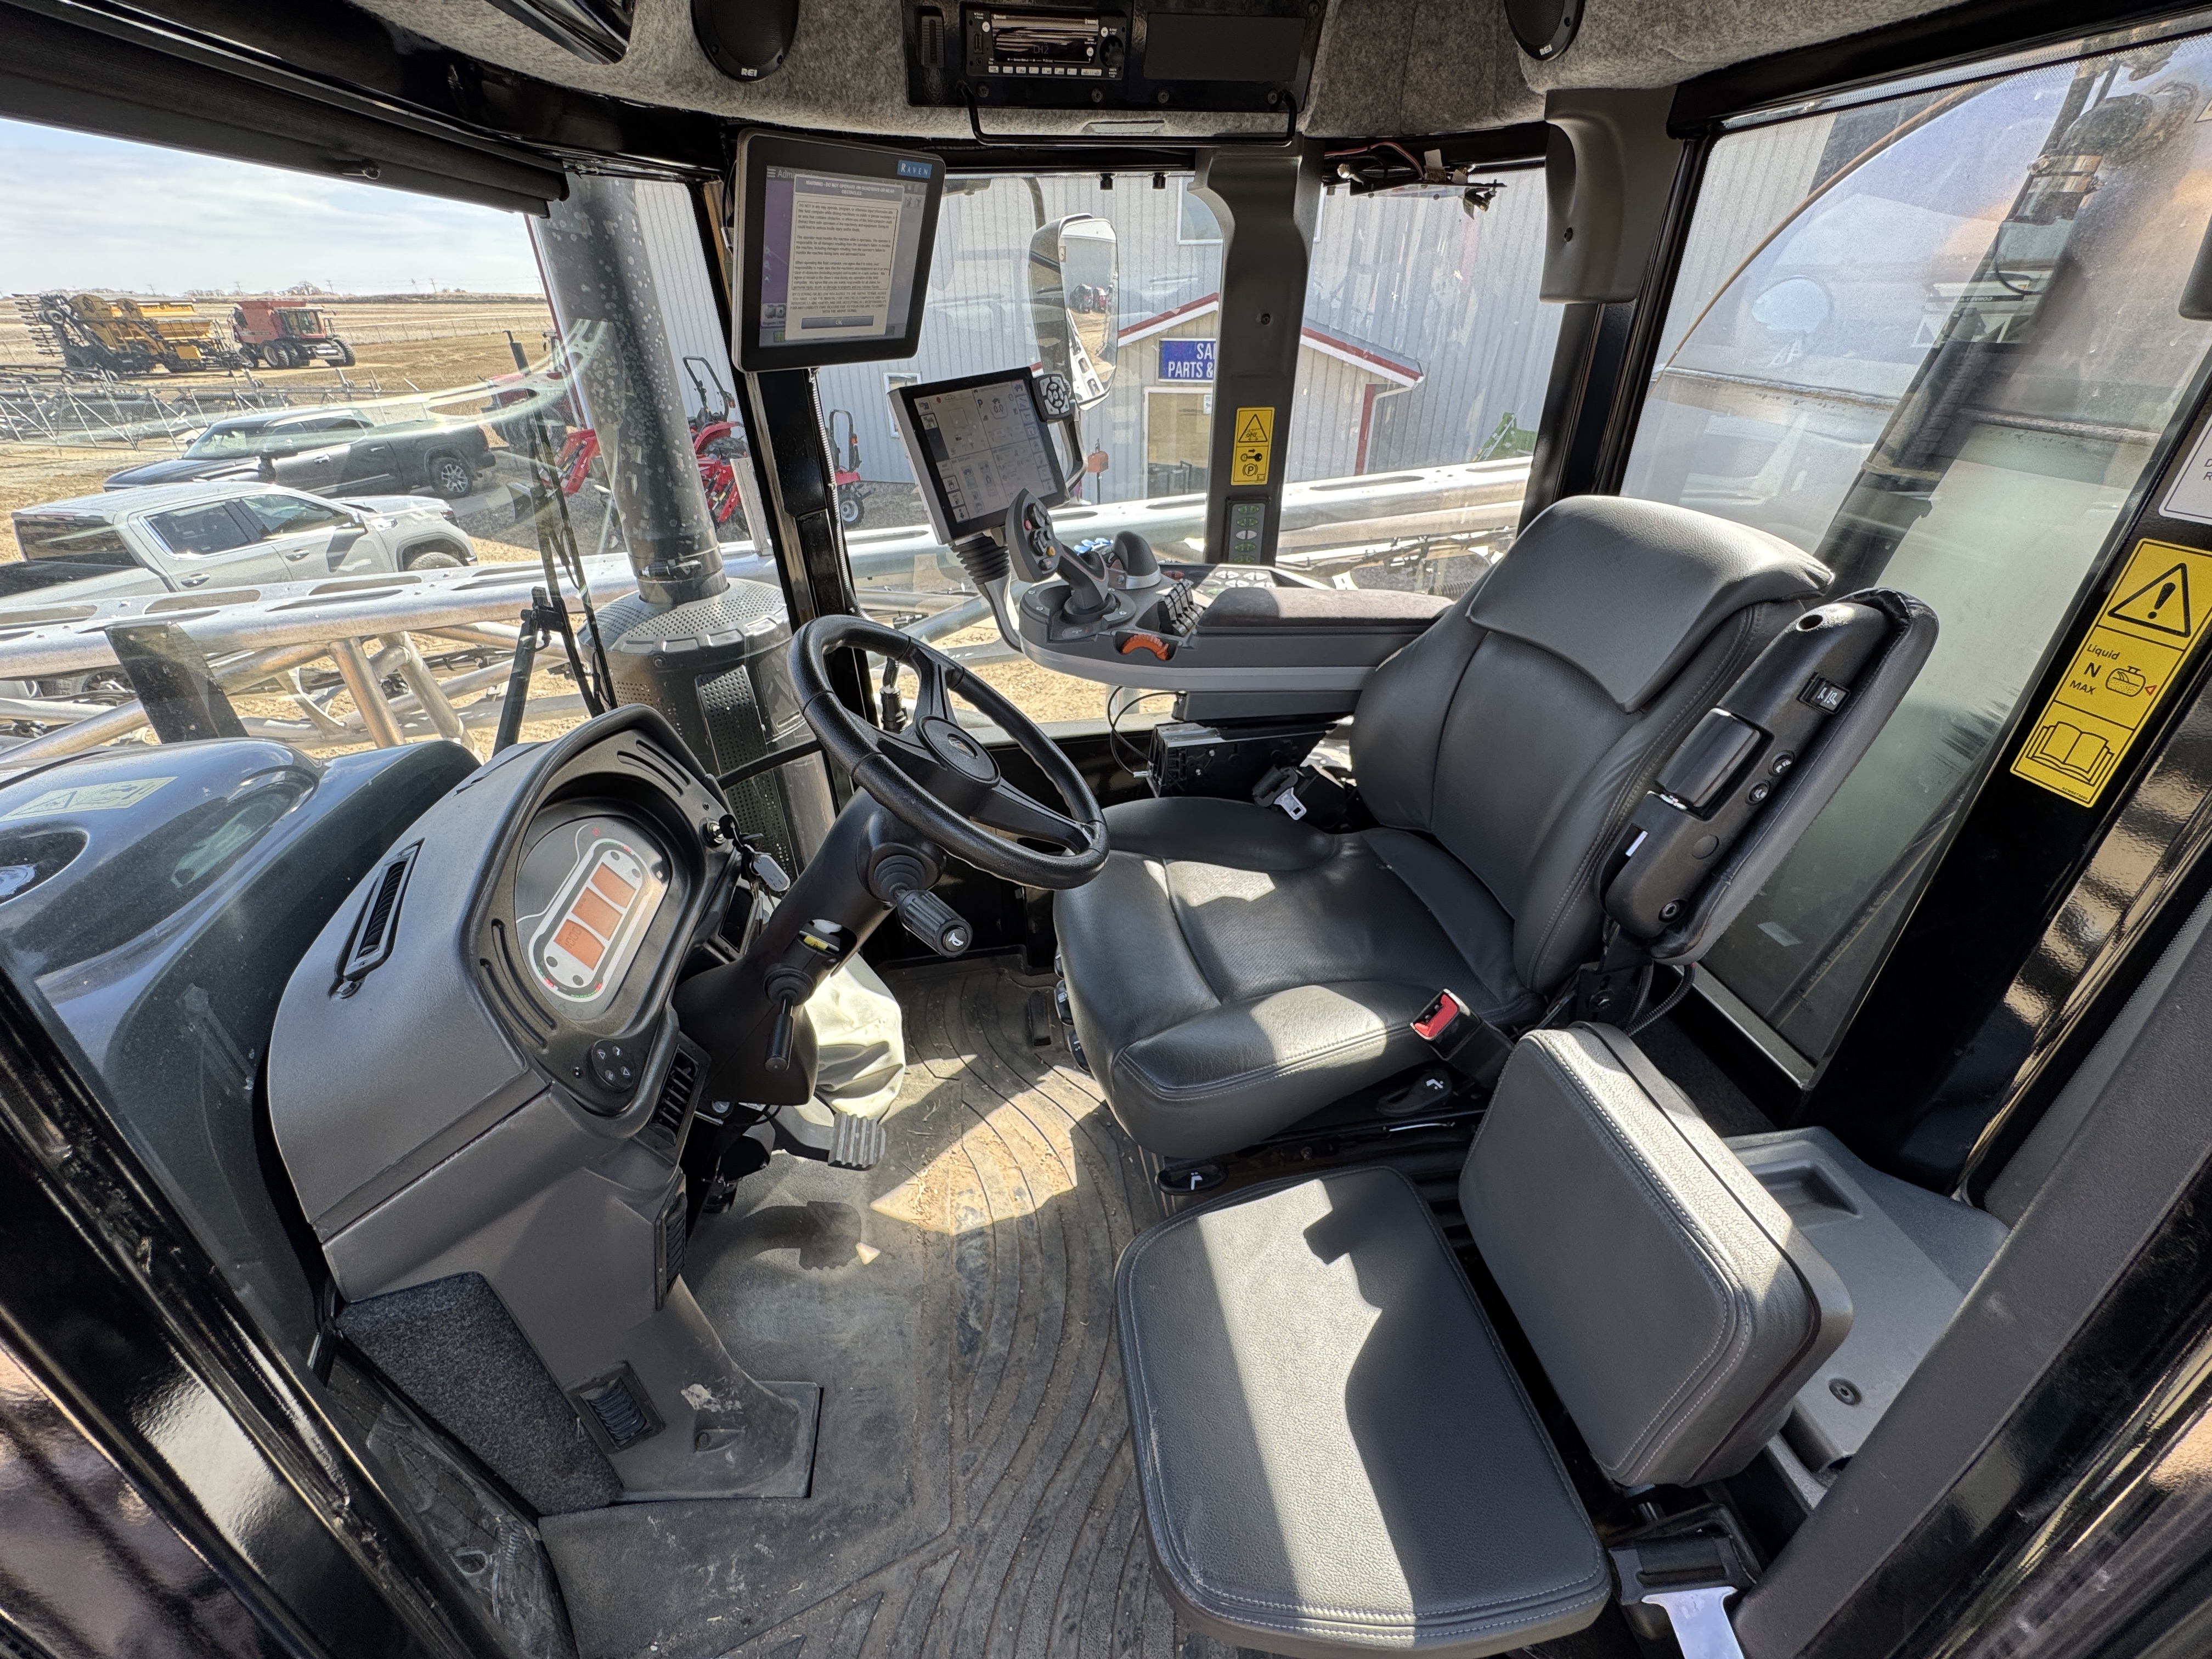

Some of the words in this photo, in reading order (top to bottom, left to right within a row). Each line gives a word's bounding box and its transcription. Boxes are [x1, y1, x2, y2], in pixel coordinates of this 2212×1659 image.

[1539, 44, 1553, 56] REI
[741, 67, 758, 77] REI
[901, 163, 928, 176] RAVEN
[1168, 361, 1204, 378] PARTS
[1206, 362, 1214, 378] &
[2086, 644, 2121, 661] Liquid
[2084, 662, 2102, 678] N
[2069, 680, 2096, 695] MAX
